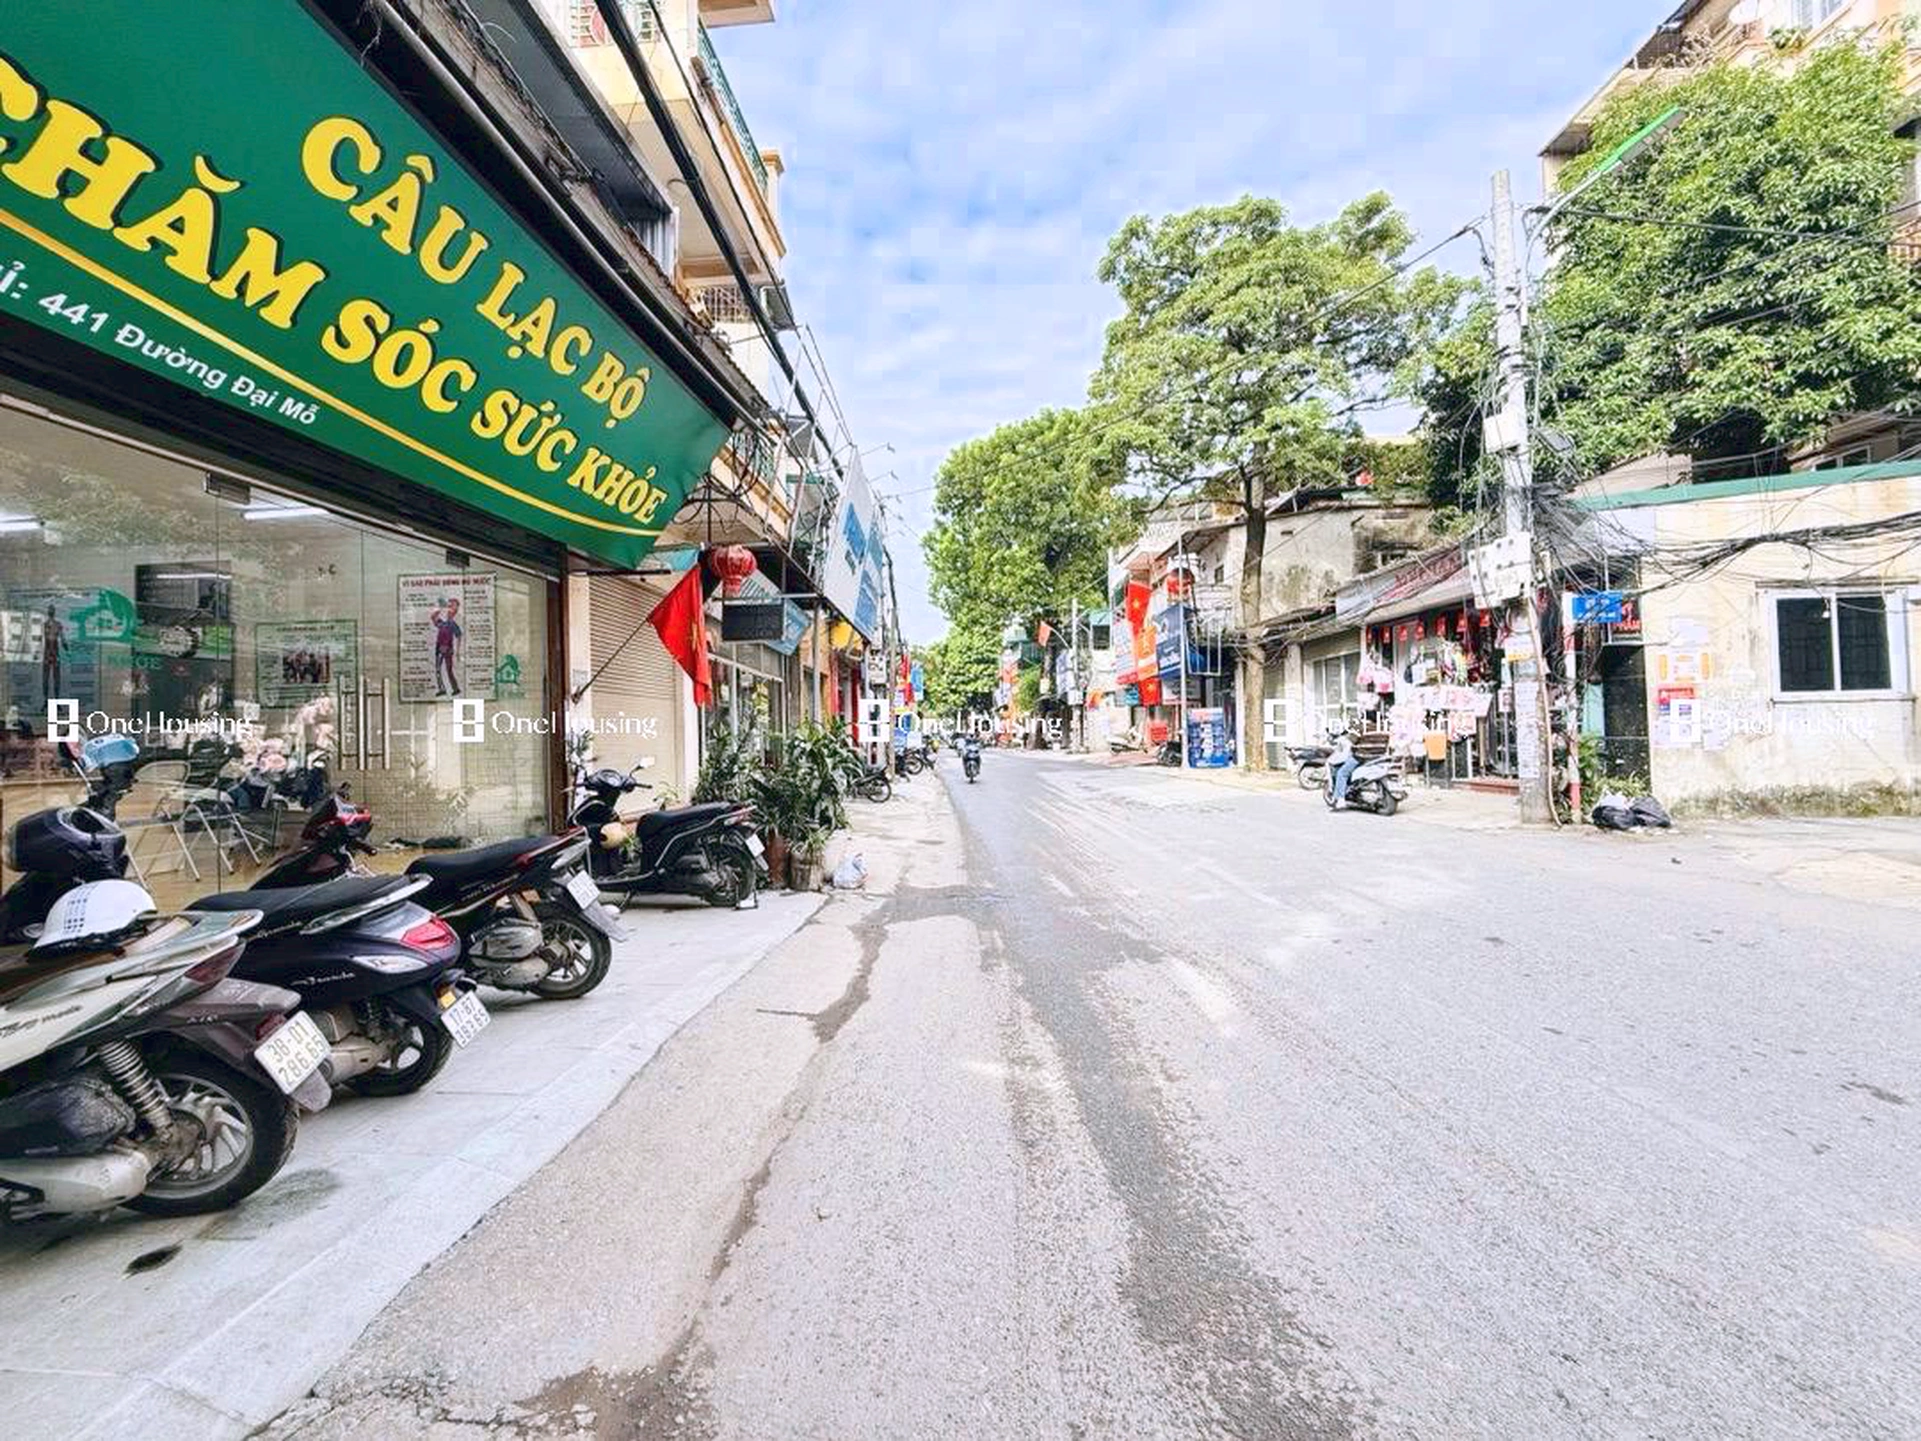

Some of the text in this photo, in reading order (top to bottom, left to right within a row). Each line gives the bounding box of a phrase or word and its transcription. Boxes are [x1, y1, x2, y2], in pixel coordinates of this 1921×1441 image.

[38, 293, 110, 333] 441
[114, 323, 227, 390] Đường
[230, 375, 278, 408] Đại
[279, 400, 319, 425] Mỗ
[302, 116, 652, 429] CÂU LẠC BỘ
[321, 299, 477, 413] SÓC
[471, 390, 578, 472] SỨC
[567, 448, 668, 525] KHỎE
